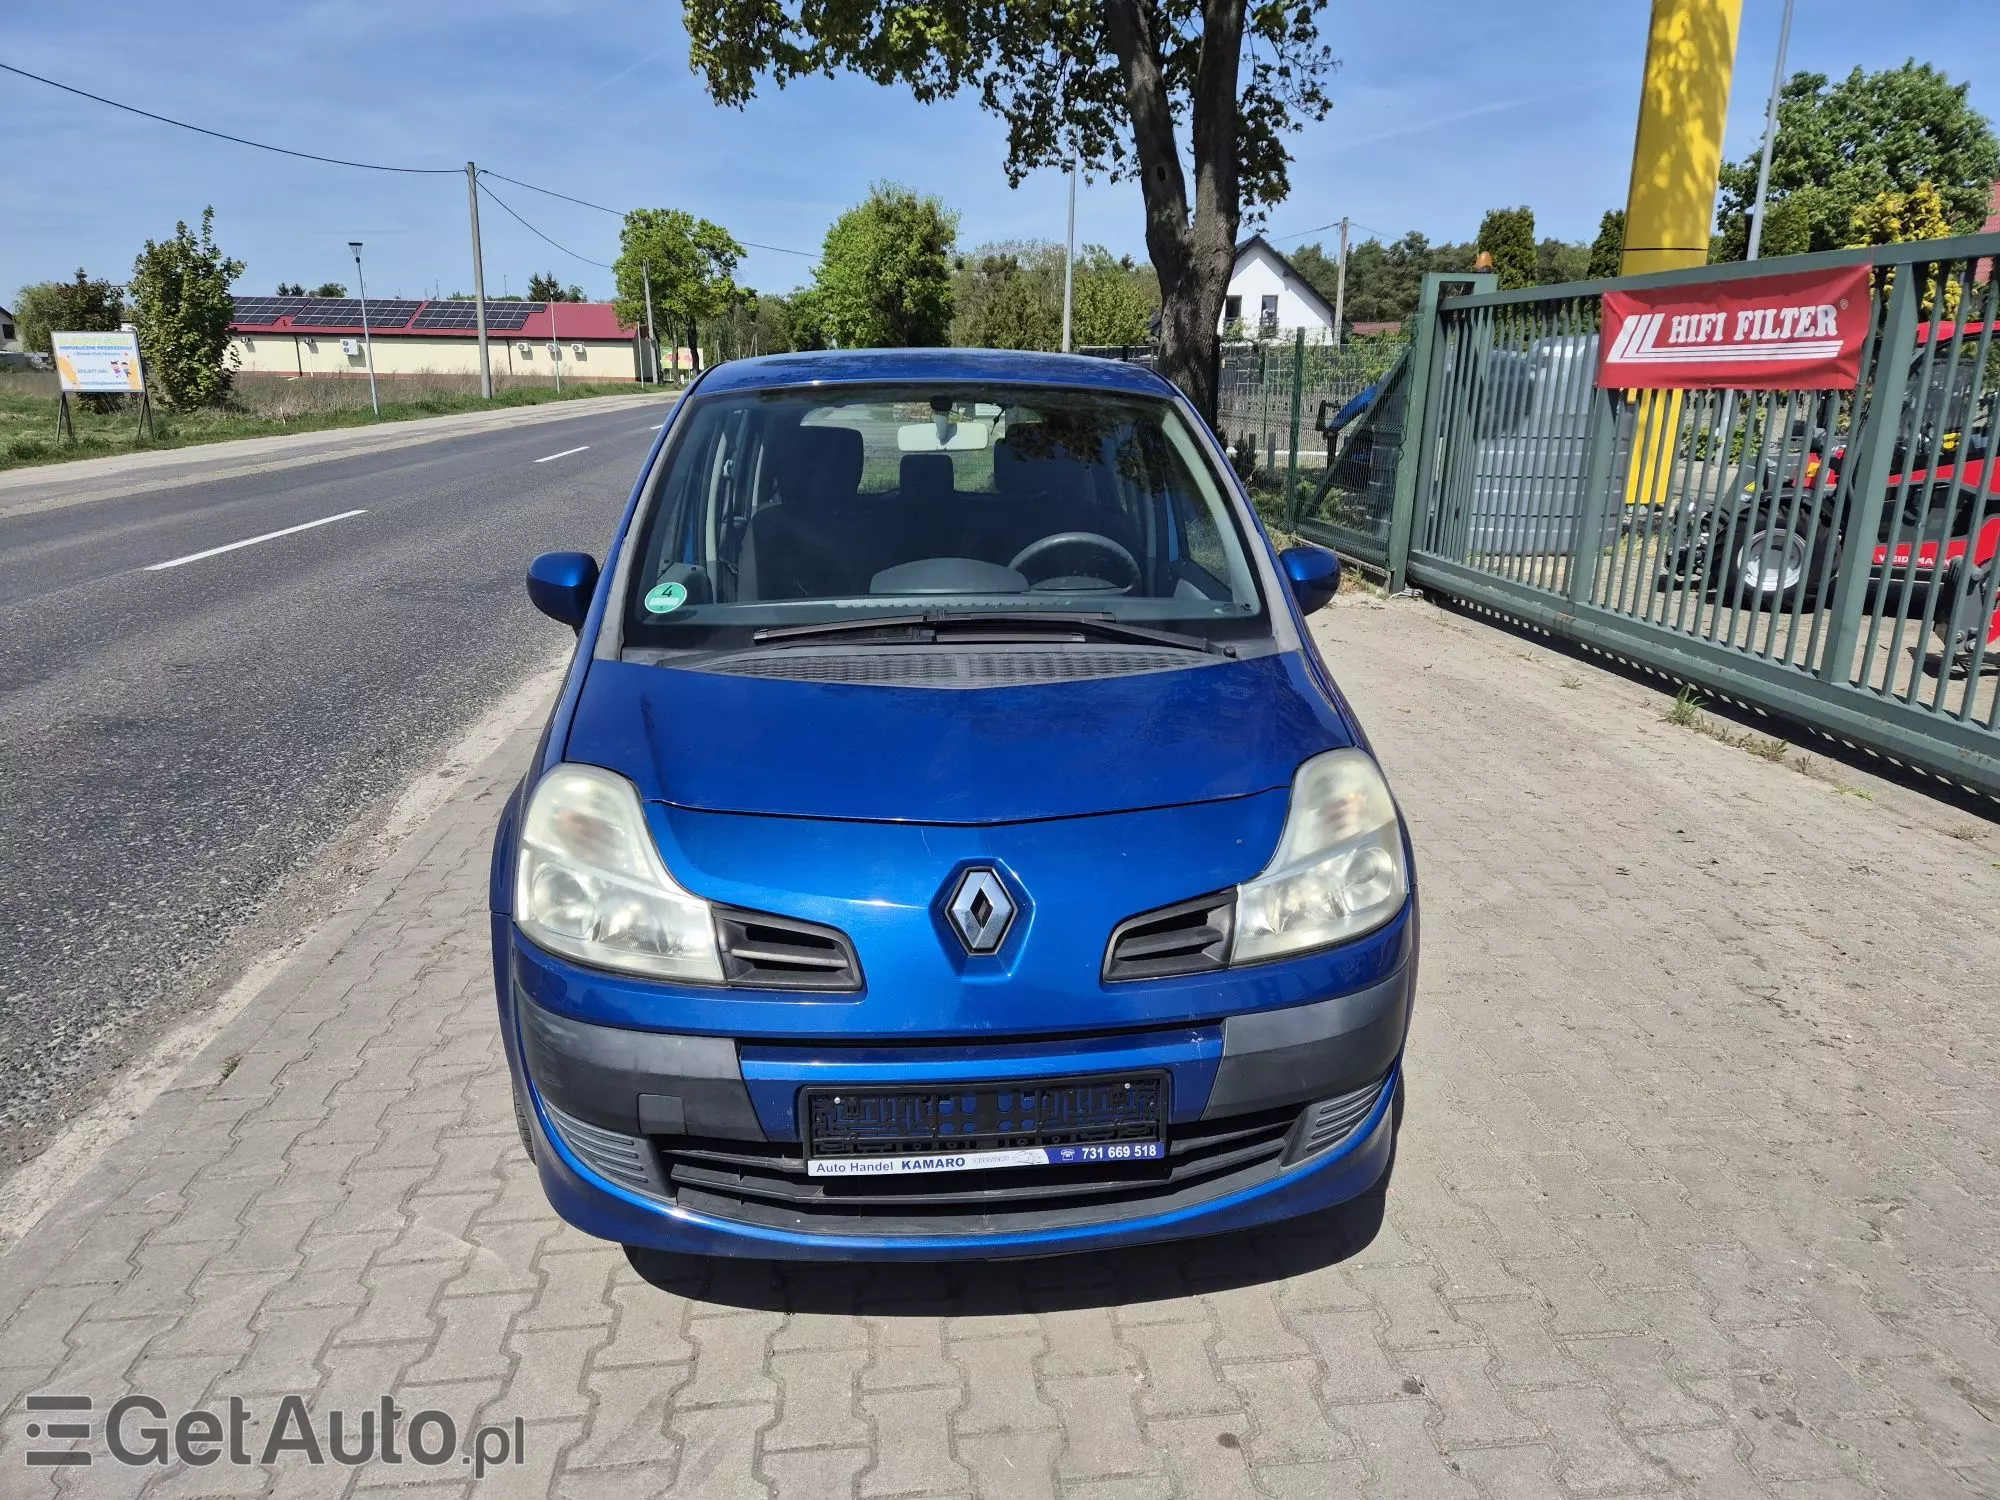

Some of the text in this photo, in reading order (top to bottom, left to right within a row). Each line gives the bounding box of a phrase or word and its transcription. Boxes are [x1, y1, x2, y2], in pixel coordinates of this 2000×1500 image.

[1667, 304, 1838, 344] HIFI FILTER
[661, 584, 673, 598] 4
[816, 1162, 846, 1173] Auto
[850, 1161, 894, 1172] Handel
[901, 1157, 966, 1171] KAMARO
[1081, 1146, 1104, 1160] 731
[1107, 1145, 1131, 1159] 669
[1134, 1144, 1157, 1158] 518
